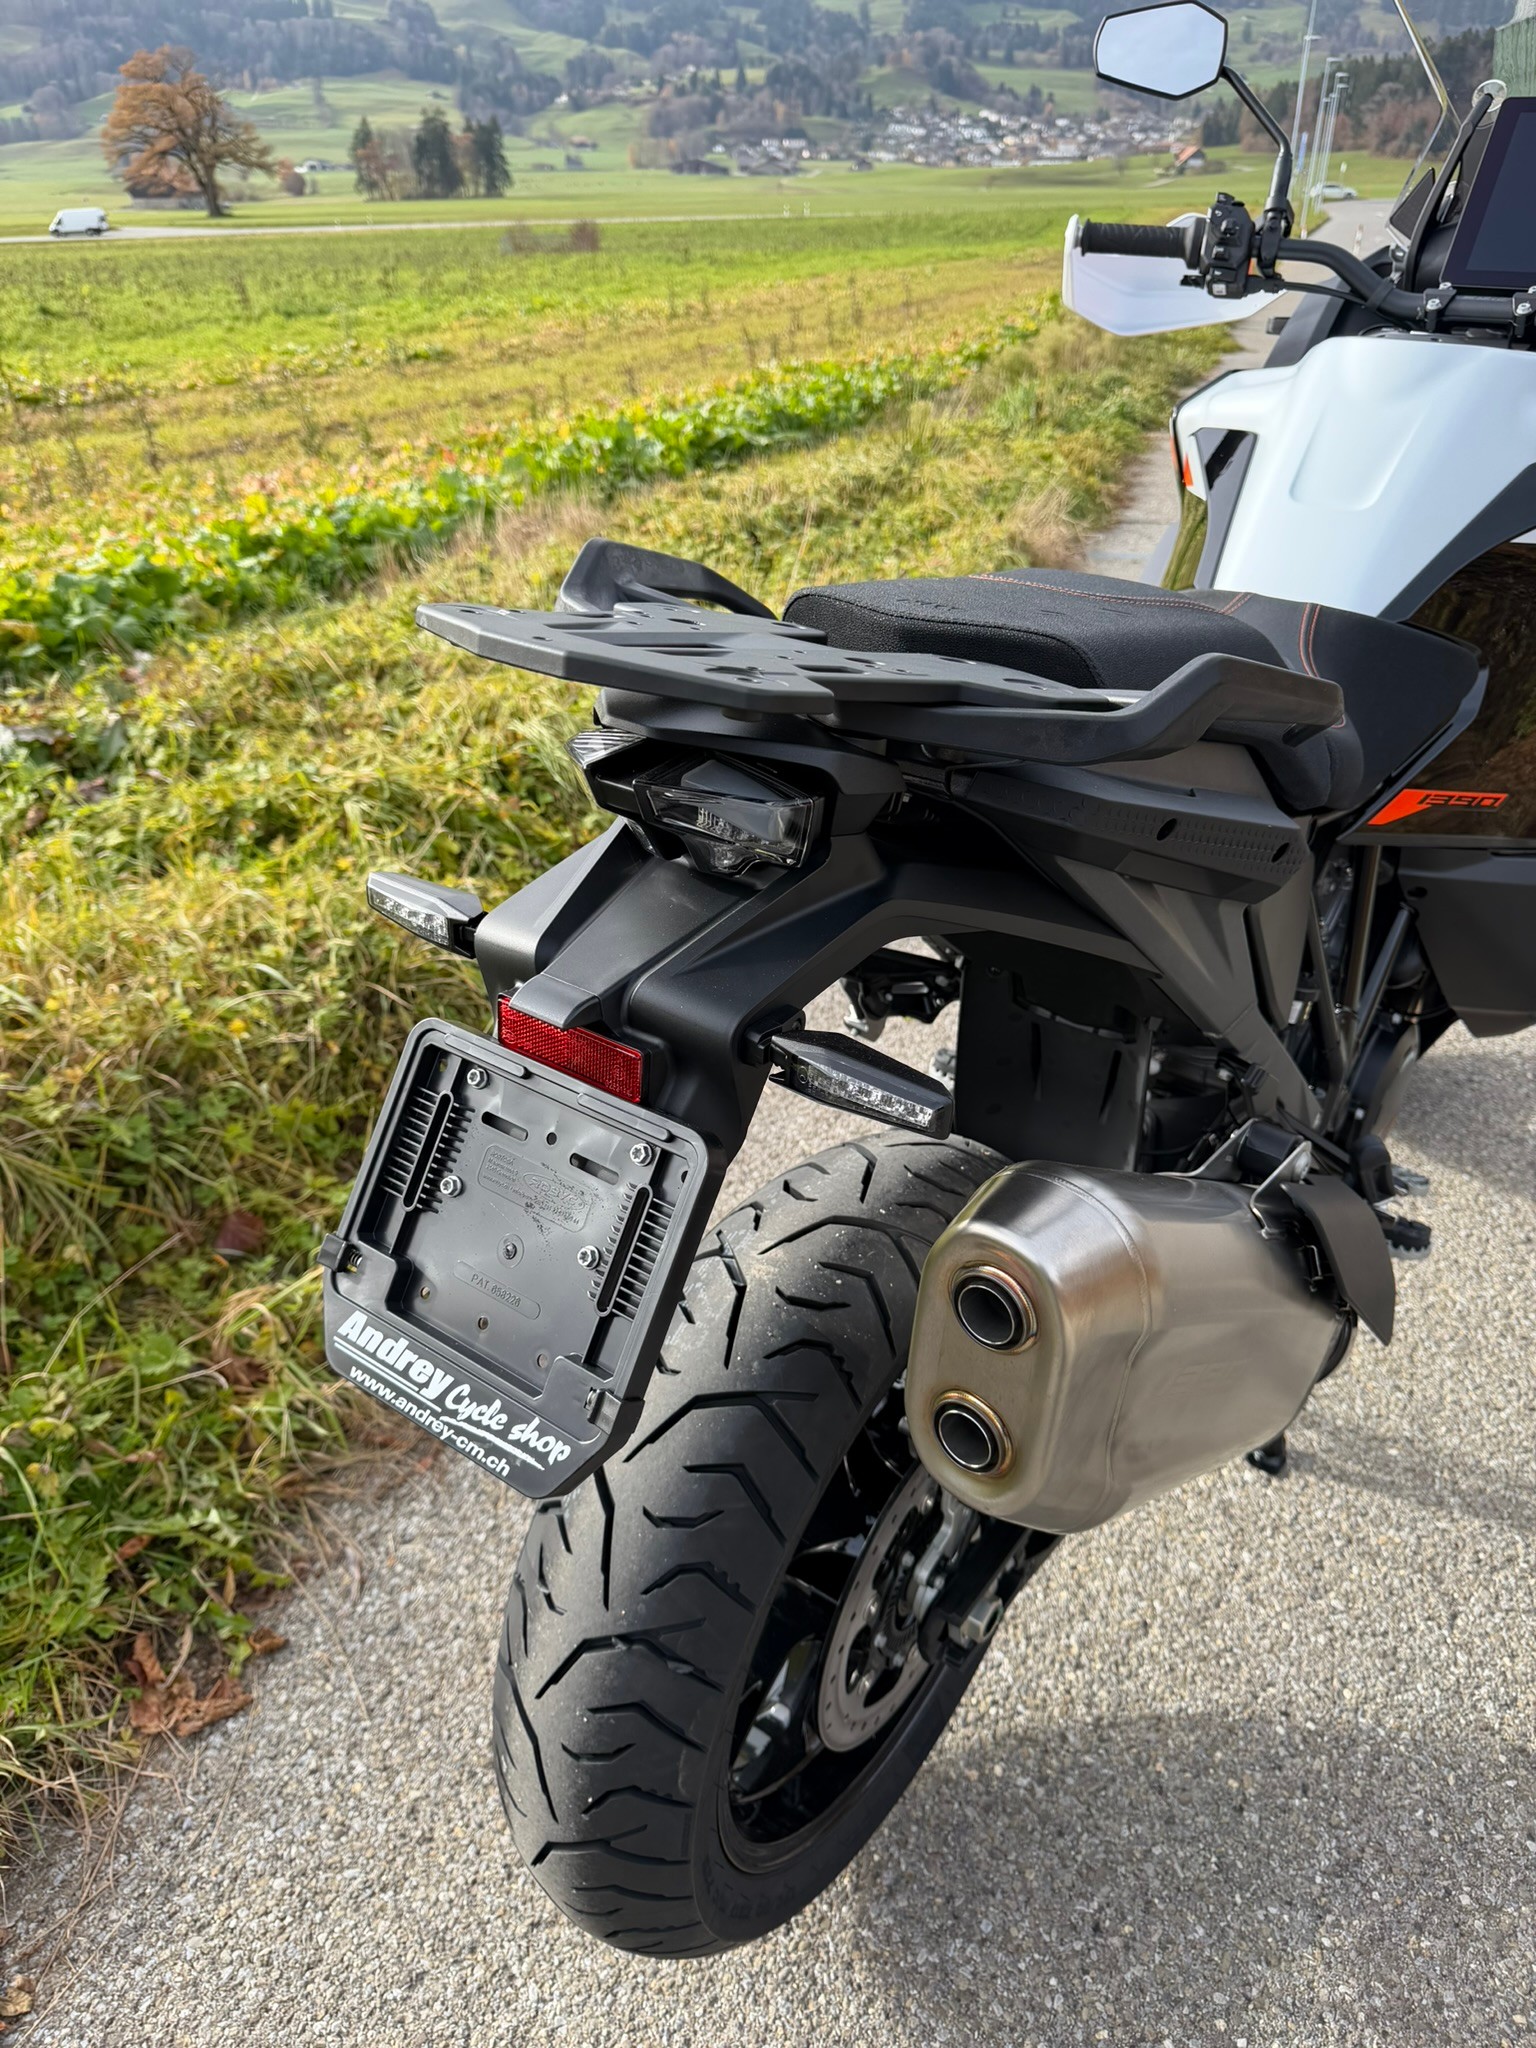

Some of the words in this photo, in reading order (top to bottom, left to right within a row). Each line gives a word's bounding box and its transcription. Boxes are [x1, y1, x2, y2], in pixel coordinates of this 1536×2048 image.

[336, 1310, 455, 1401] Andrey
[445, 1383, 510, 1430] Cycle
[509, 1416, 572, 1466] shop
[349, 1365, 512, 1478] www.andrey-cm.ch
